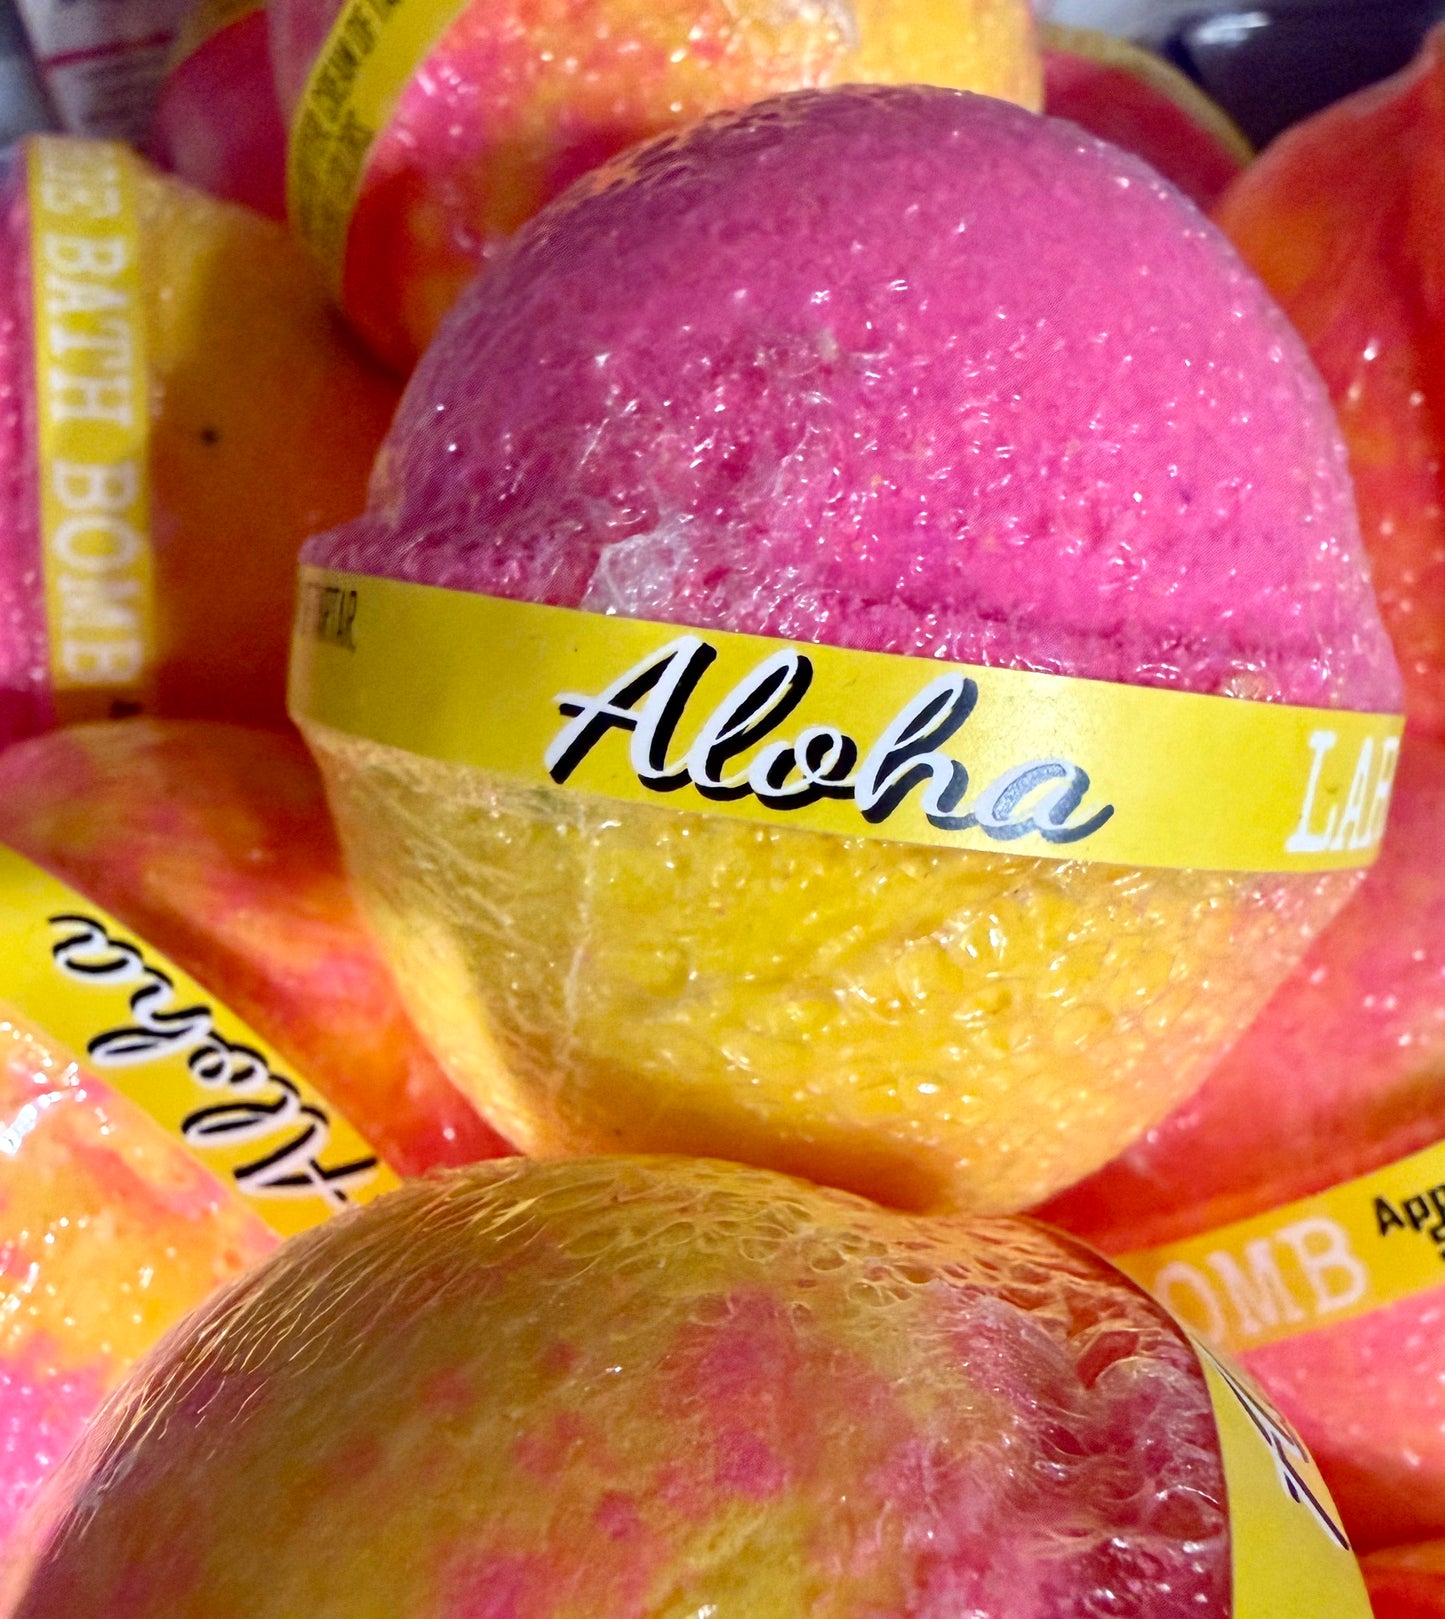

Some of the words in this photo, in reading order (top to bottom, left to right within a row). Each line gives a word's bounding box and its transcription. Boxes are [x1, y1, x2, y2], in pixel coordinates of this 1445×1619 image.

[46, 233, 134, 424] BATH
[53, 463, 144, 684] BOMB
[545, 635, 1114, 844] Aloha
[47, 914, 380, 1204] Aloha
